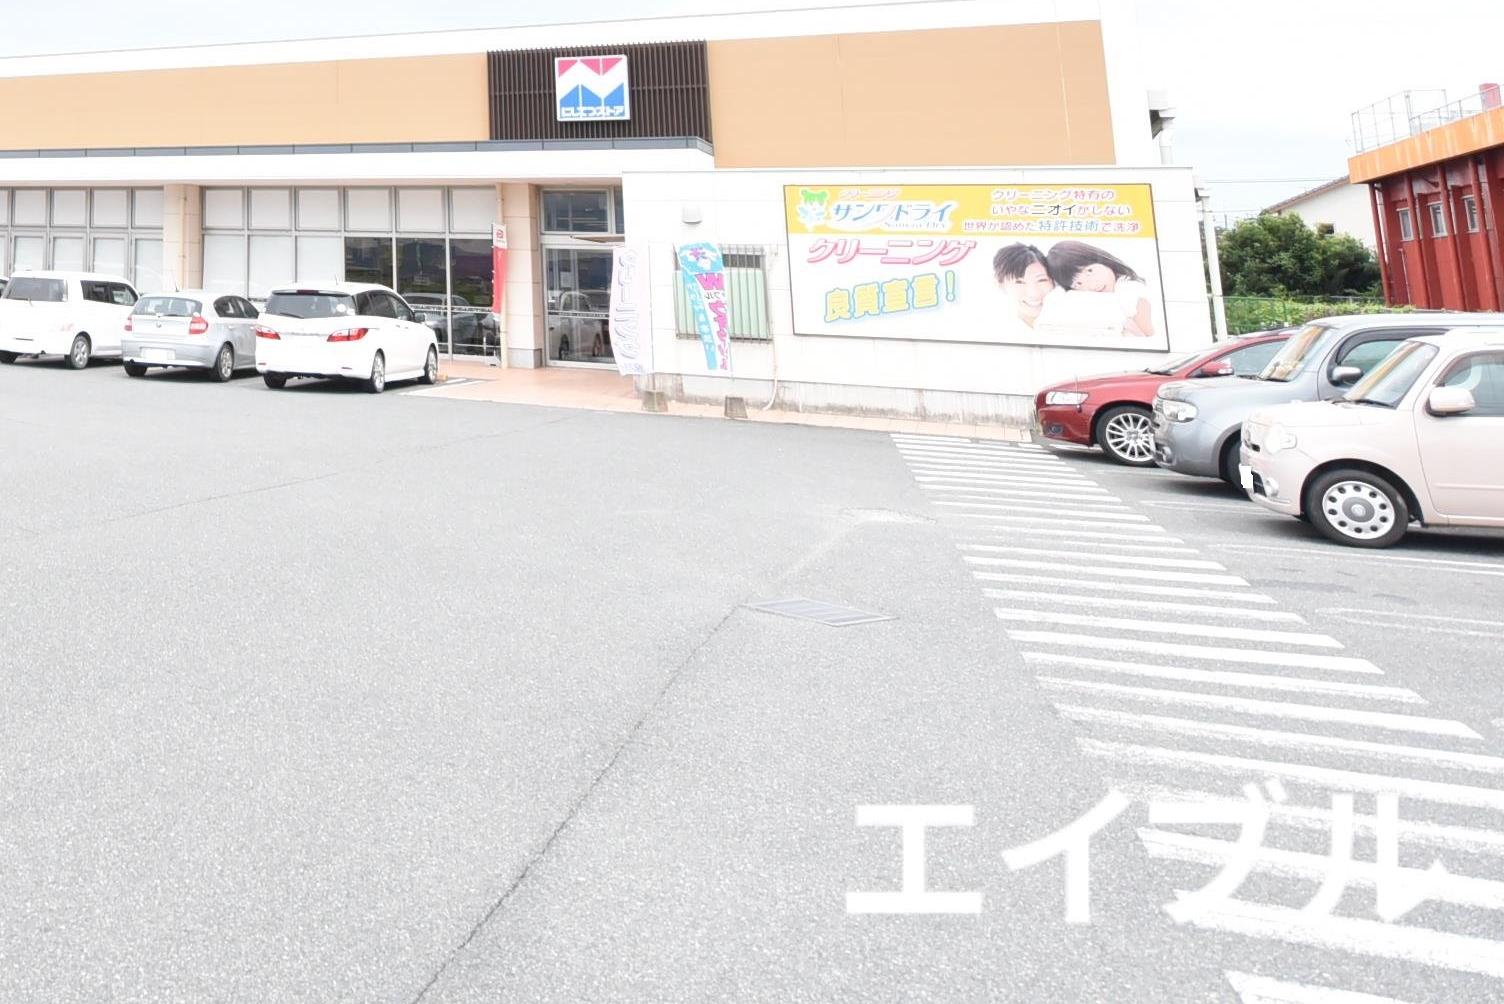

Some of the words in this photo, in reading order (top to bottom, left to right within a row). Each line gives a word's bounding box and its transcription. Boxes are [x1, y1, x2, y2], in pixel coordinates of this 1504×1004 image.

[834, 203, 953, 223] サンワドライ
[992, 204, 1131, 216] いやなニオイがしない
[807, 239, 978, 267] クリーニング
